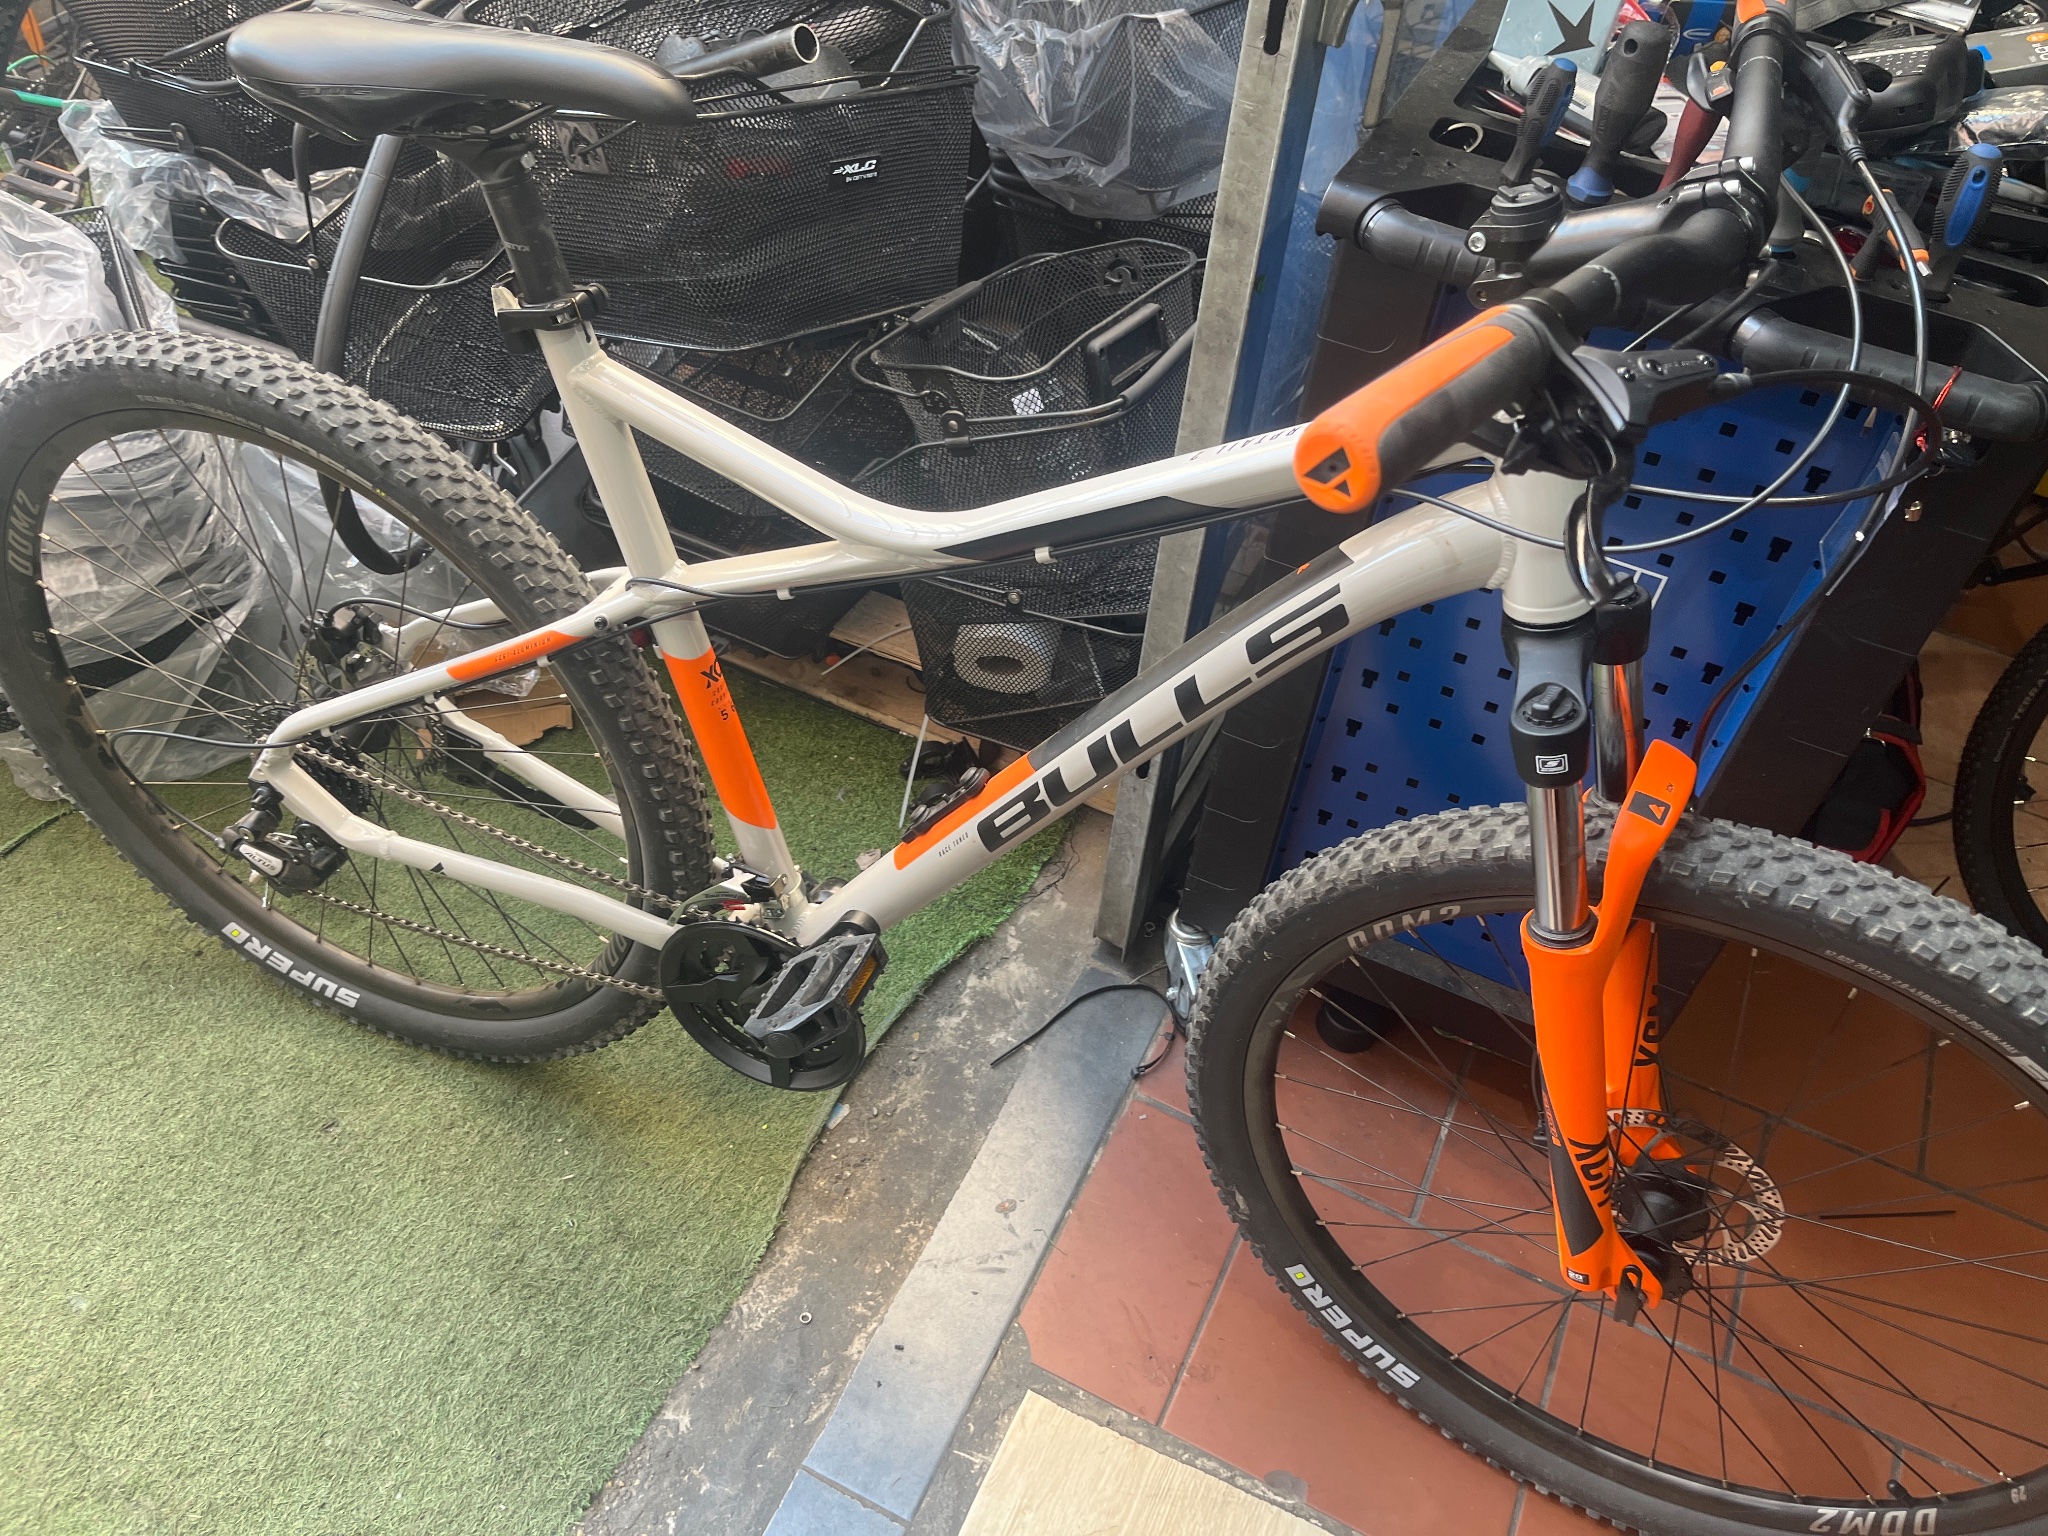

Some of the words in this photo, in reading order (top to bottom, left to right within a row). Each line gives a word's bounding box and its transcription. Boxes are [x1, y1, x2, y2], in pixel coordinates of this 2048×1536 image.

[836, 159, 877, 175] XLC
[7, 488, 40, 577] DDM2
[976, 582, 1350, 854] BULLS
[244, 852, 277, 871] ALTUS
[1346, 904, 1461, 954] DDM2
[221, 921, 361, 1009] SUPERO
[1284, 1263, 1422, 1390] SUPERO
[1809, 1507, 1938, 1536] DDM2
